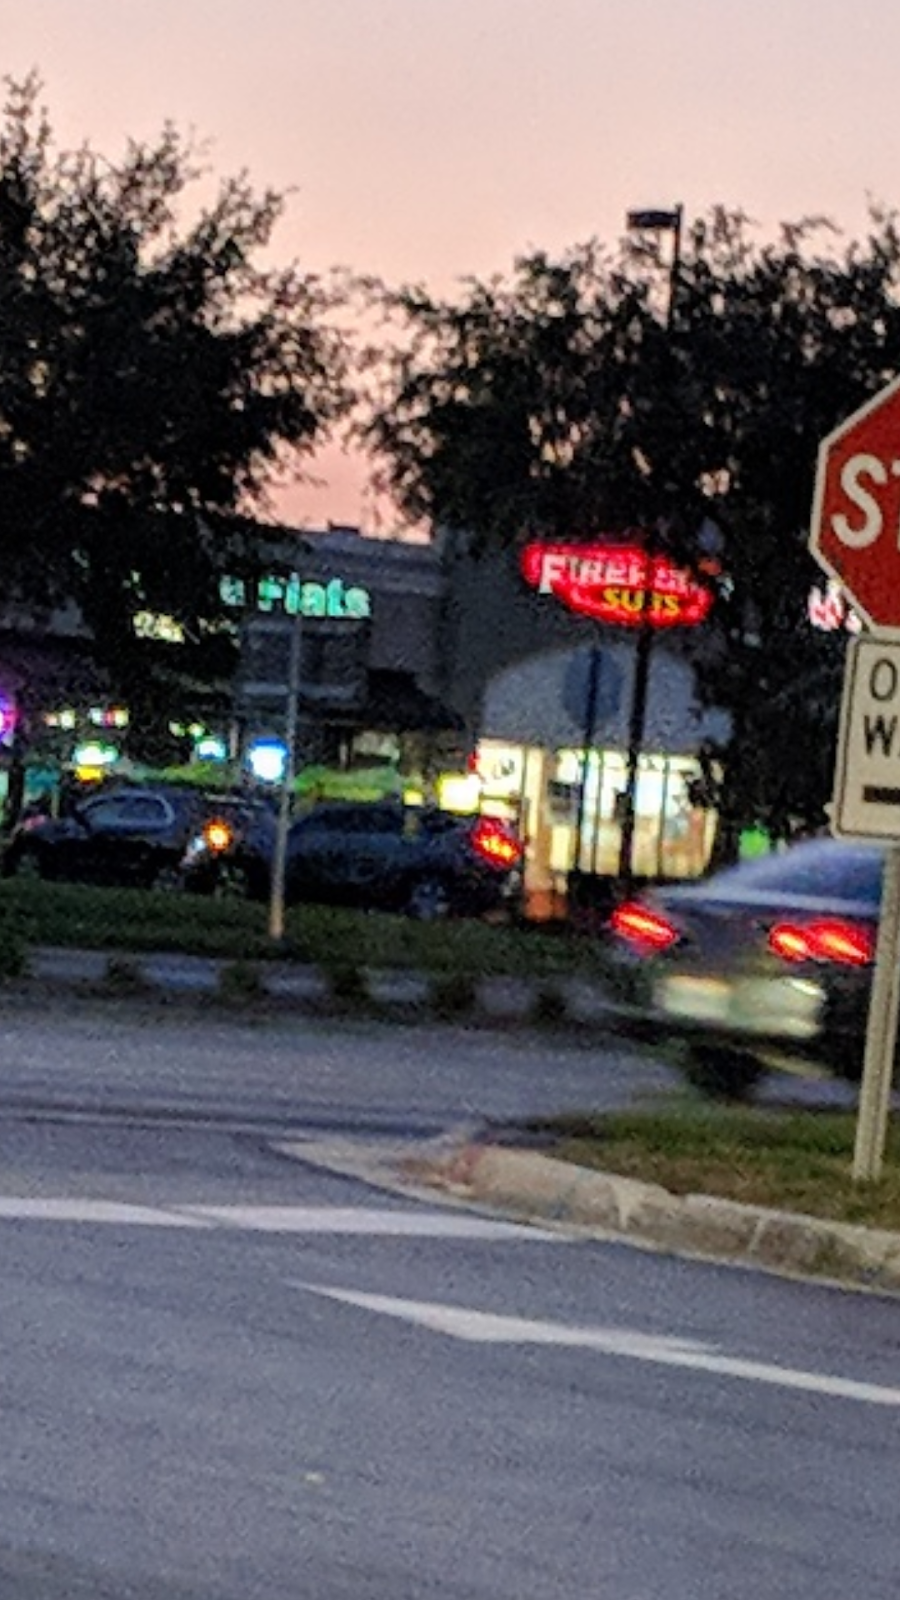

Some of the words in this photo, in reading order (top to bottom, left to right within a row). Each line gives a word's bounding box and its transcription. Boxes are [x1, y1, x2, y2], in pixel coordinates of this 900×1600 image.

[831, 453, 900, 549] S
[602, 587, 681, 617] SUS
[863, 714, 900, 758] W
